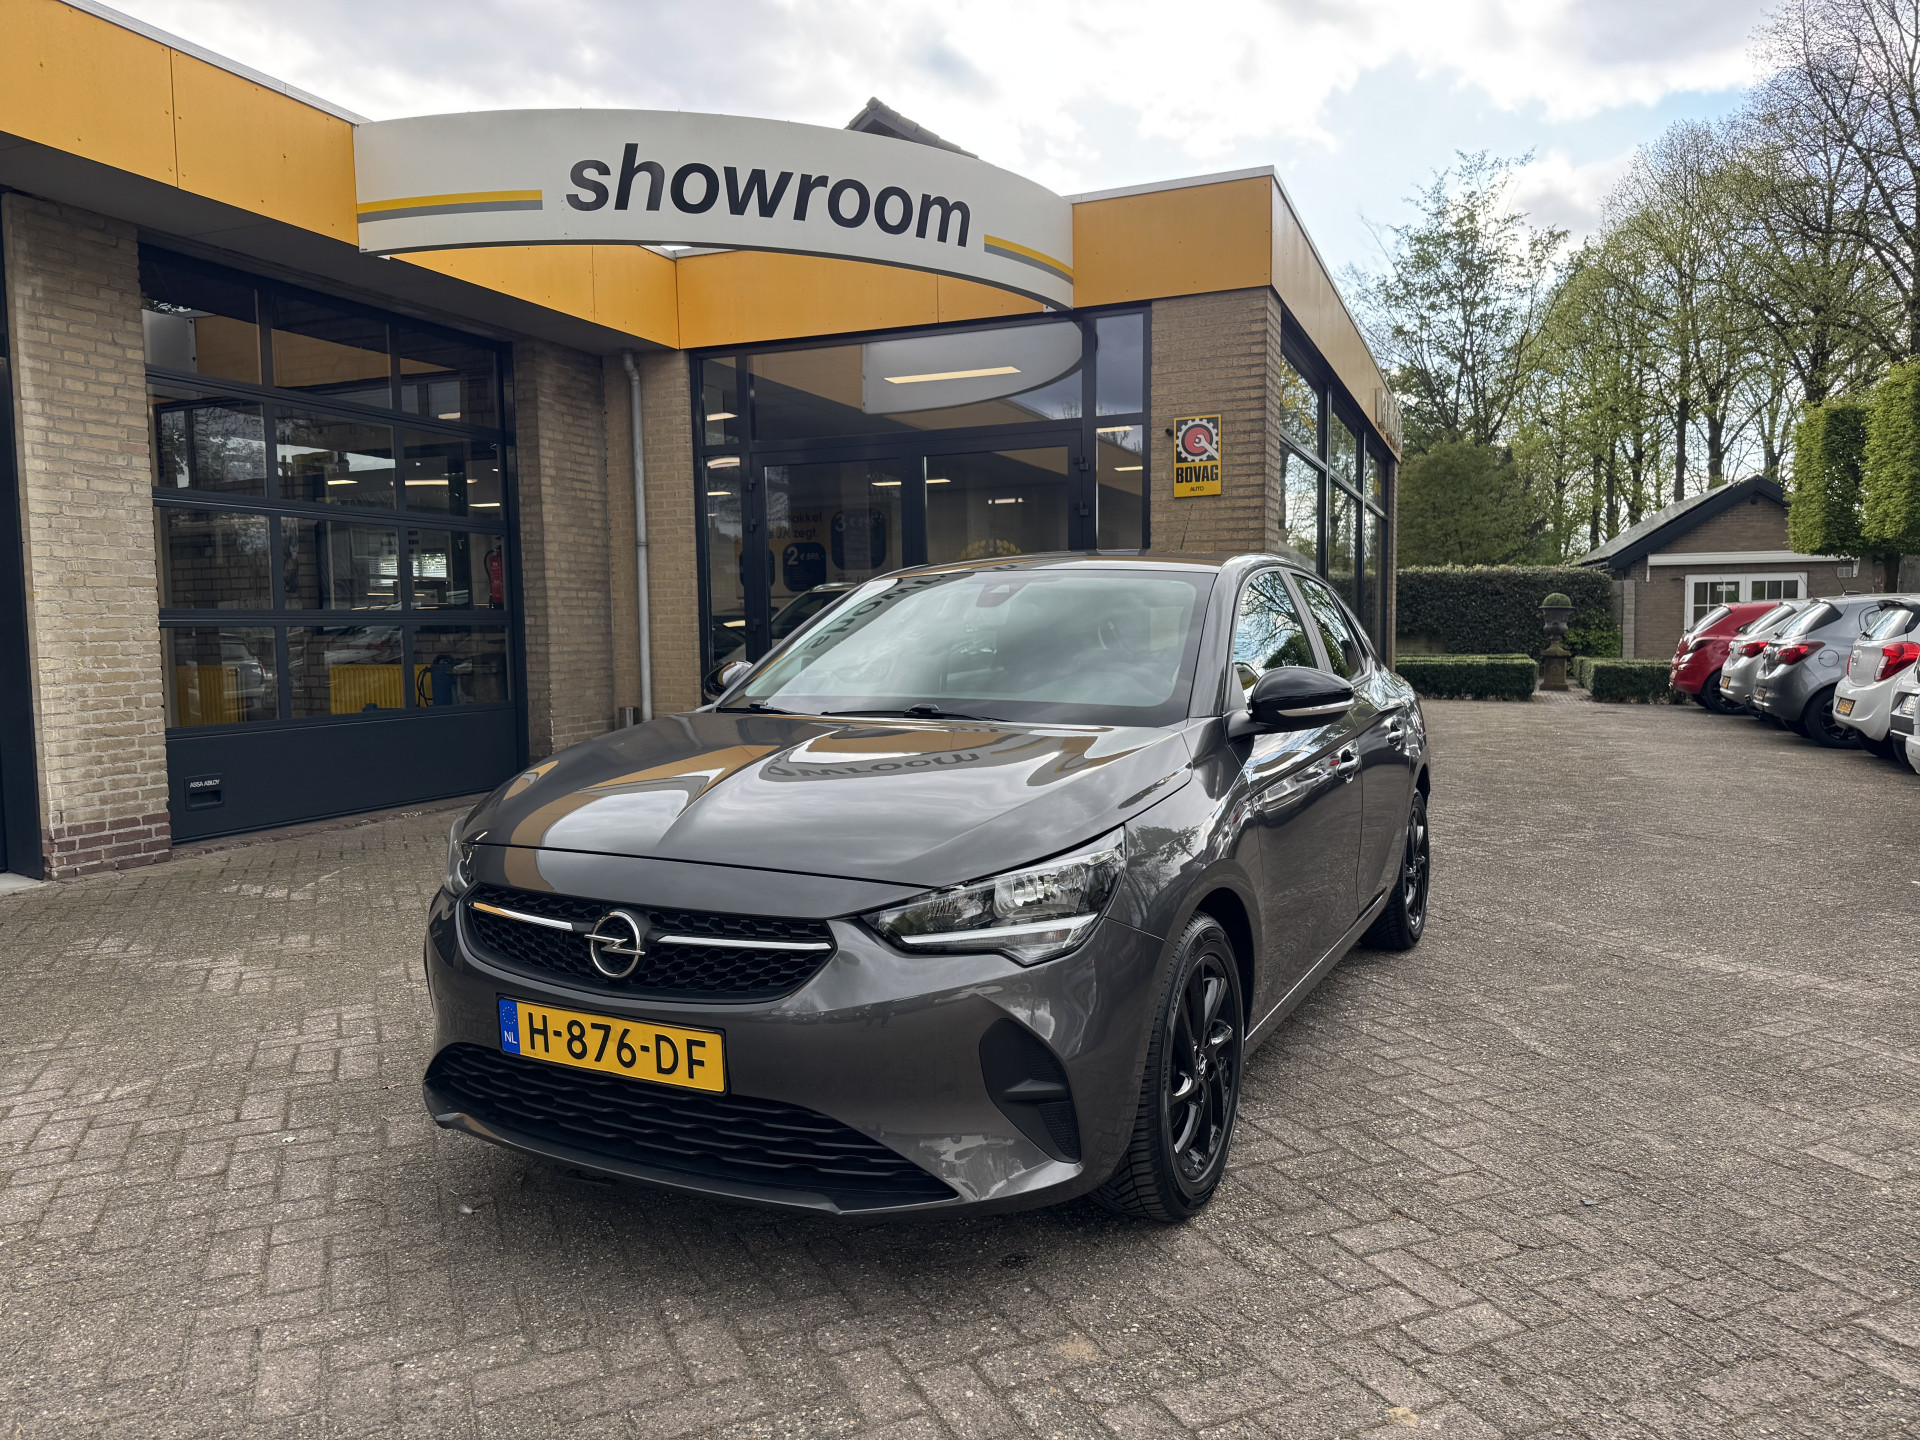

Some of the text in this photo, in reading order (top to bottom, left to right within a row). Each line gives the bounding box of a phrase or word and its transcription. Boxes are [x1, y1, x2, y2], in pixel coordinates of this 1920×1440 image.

[566, 143, 970, 248] showroom
[1175, 465, 1219, 484] BOVAG
[786, 546, 799, 566] 2
[504, 1029, 518, 1044] NL
[528, 1012, 706, 1079] H-876-DF
